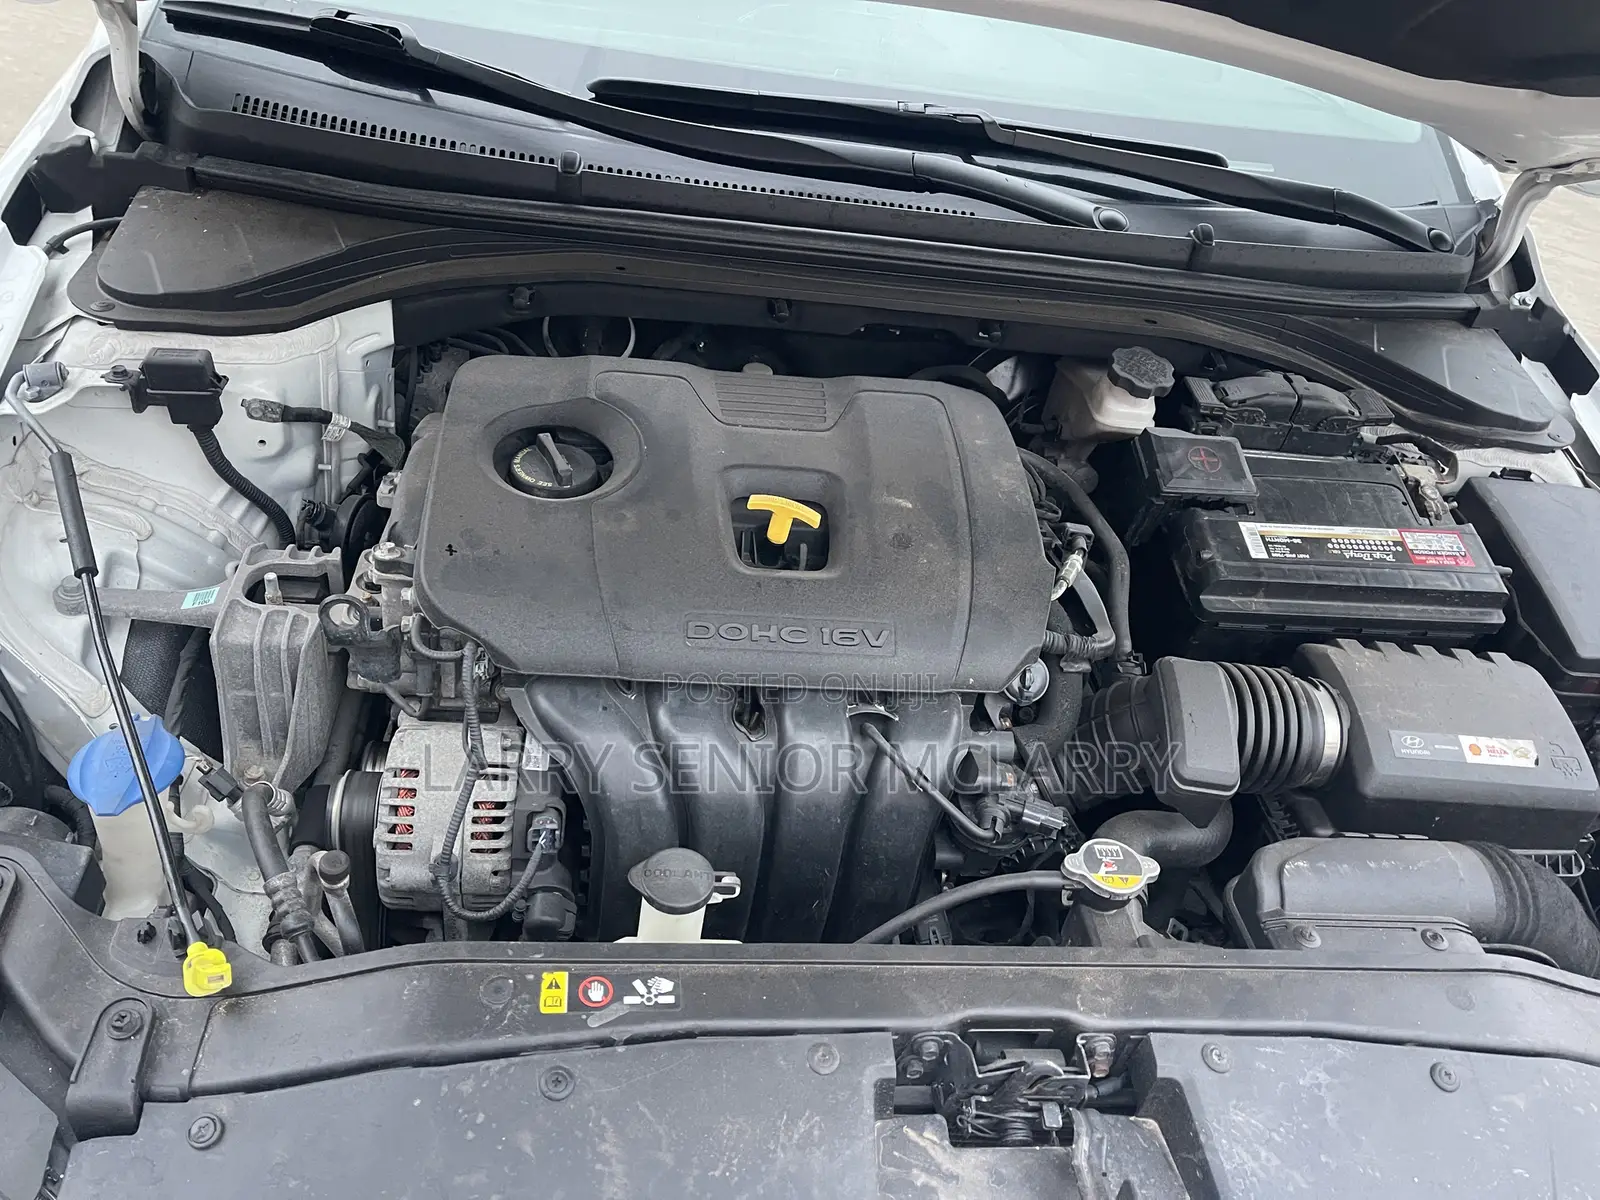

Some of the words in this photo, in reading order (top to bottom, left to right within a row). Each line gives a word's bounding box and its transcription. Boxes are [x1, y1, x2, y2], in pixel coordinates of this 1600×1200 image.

[685, 620, 809, 644] DOHC
[820, 626, 890, 649] 16V
[1400, 748, 1431, 756] HYUNDAI
[644, 868, 713, 881] COOLANT
